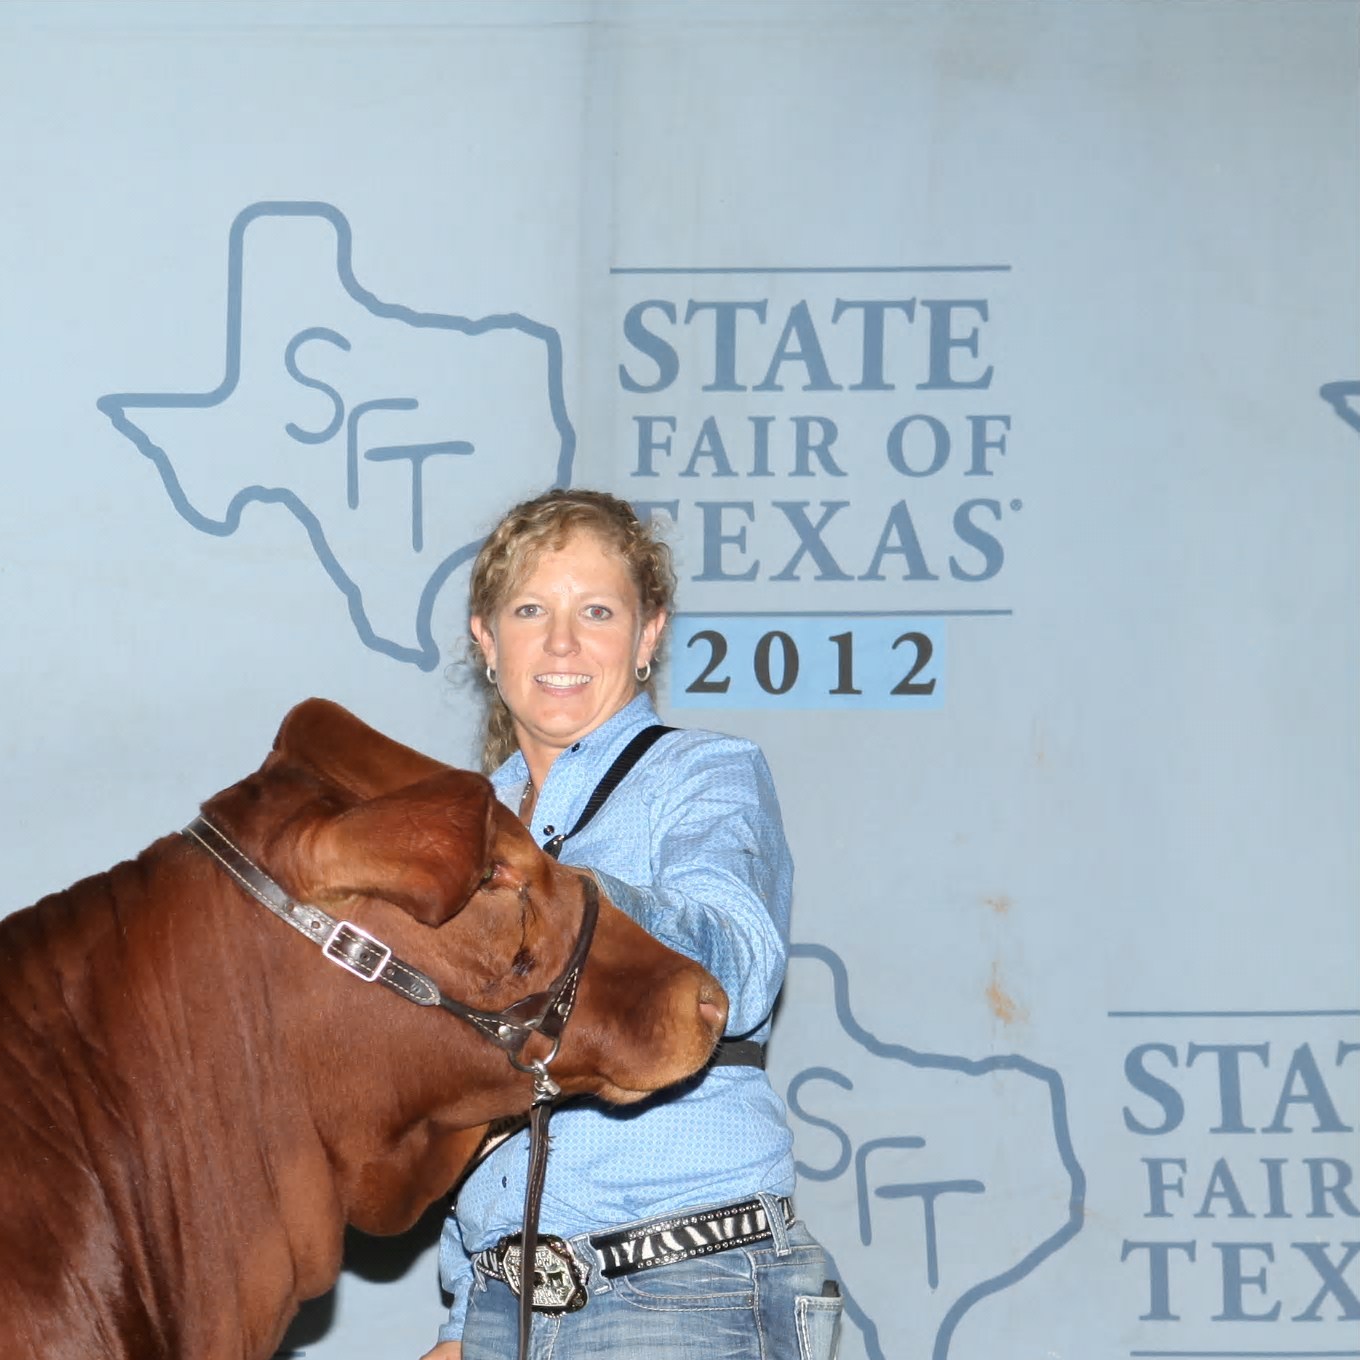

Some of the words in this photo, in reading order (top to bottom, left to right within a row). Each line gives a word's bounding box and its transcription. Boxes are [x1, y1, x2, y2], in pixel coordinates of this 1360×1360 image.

[619, 297, 994, 394] STATE
[630, 415, 848, 478] FAIR
[886, 414, 1011, 478] OF
[635, 498, 1006, 583] EXAS
[685, 630, 937, 696] 2012
[1122, 1040, 1360, 1136] STA
[1139, 1155, 1360, 1219] FAIR
